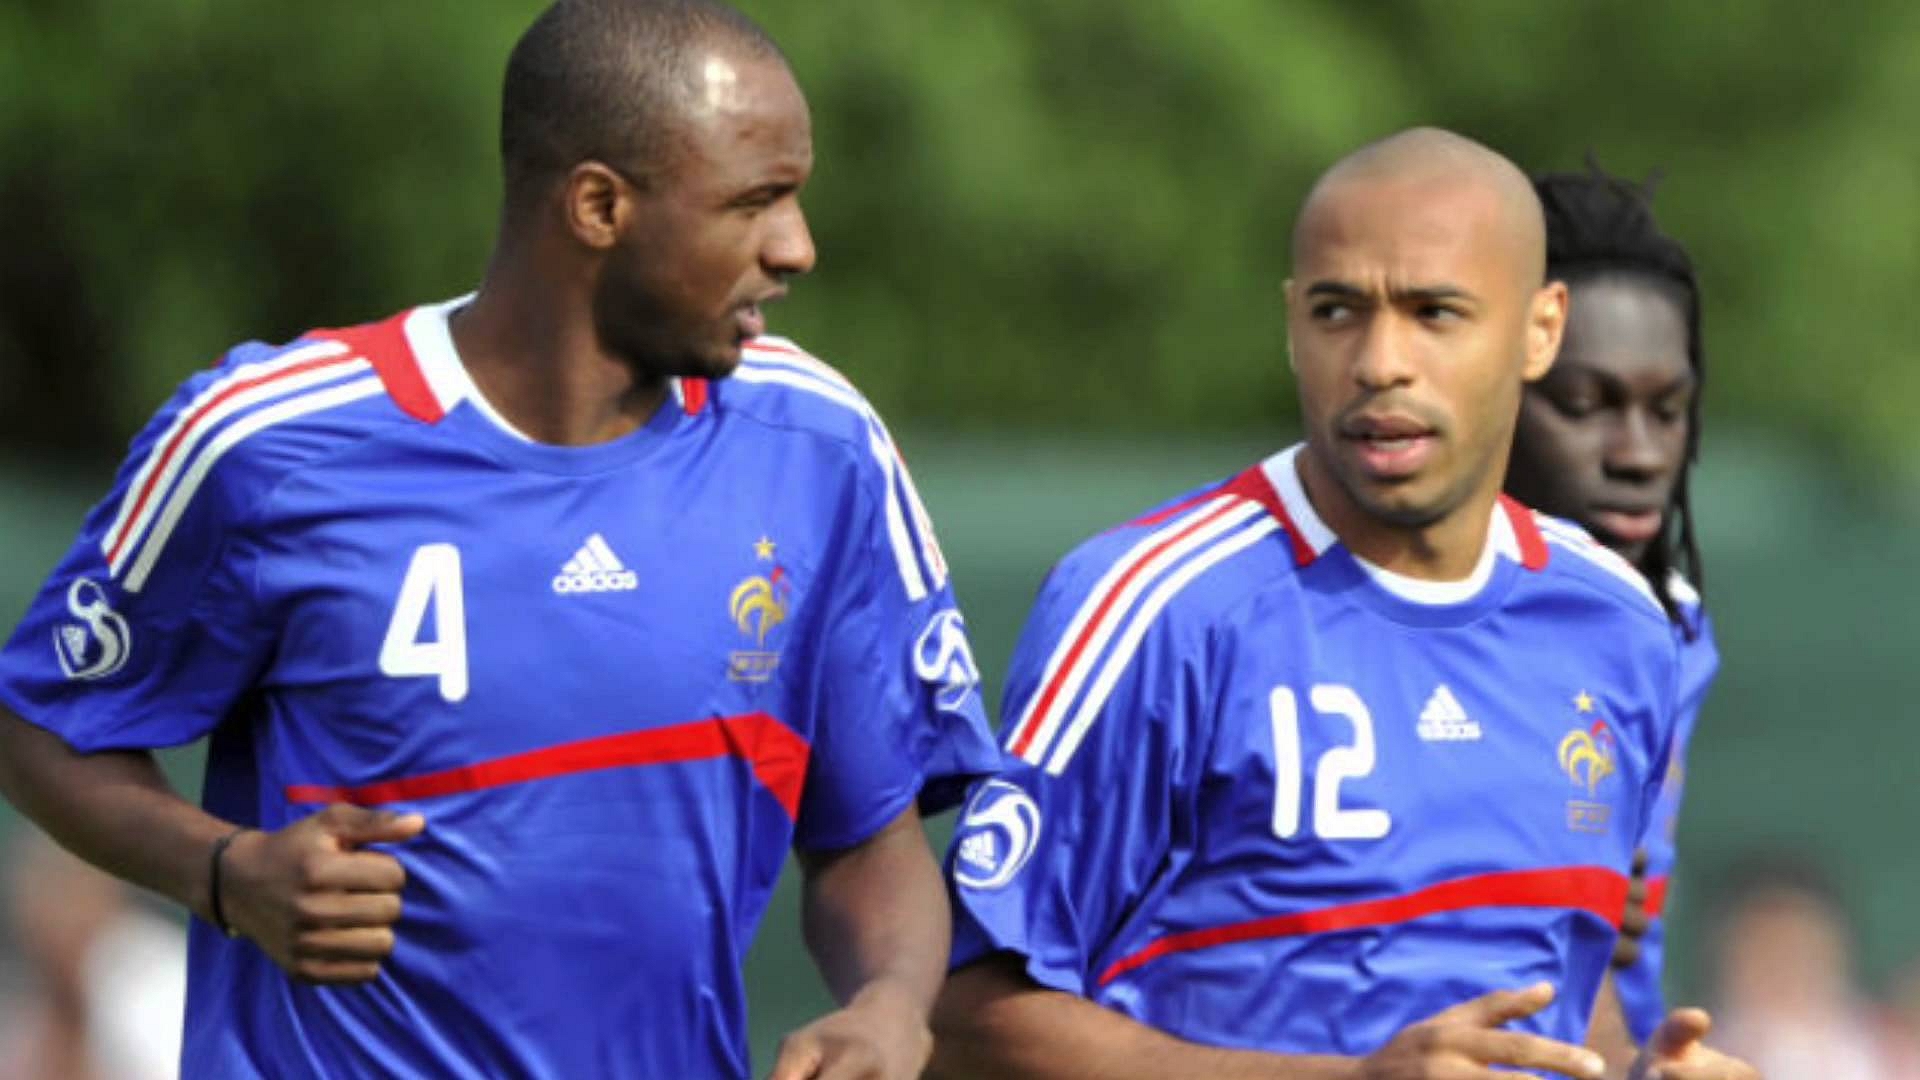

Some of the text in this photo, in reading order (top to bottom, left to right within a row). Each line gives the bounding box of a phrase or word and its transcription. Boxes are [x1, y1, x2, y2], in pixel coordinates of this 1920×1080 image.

[379, 543, 469, 702] 4
[552, 569, 638, 594] adidas
[1269, 684, 1391, 839] 12
